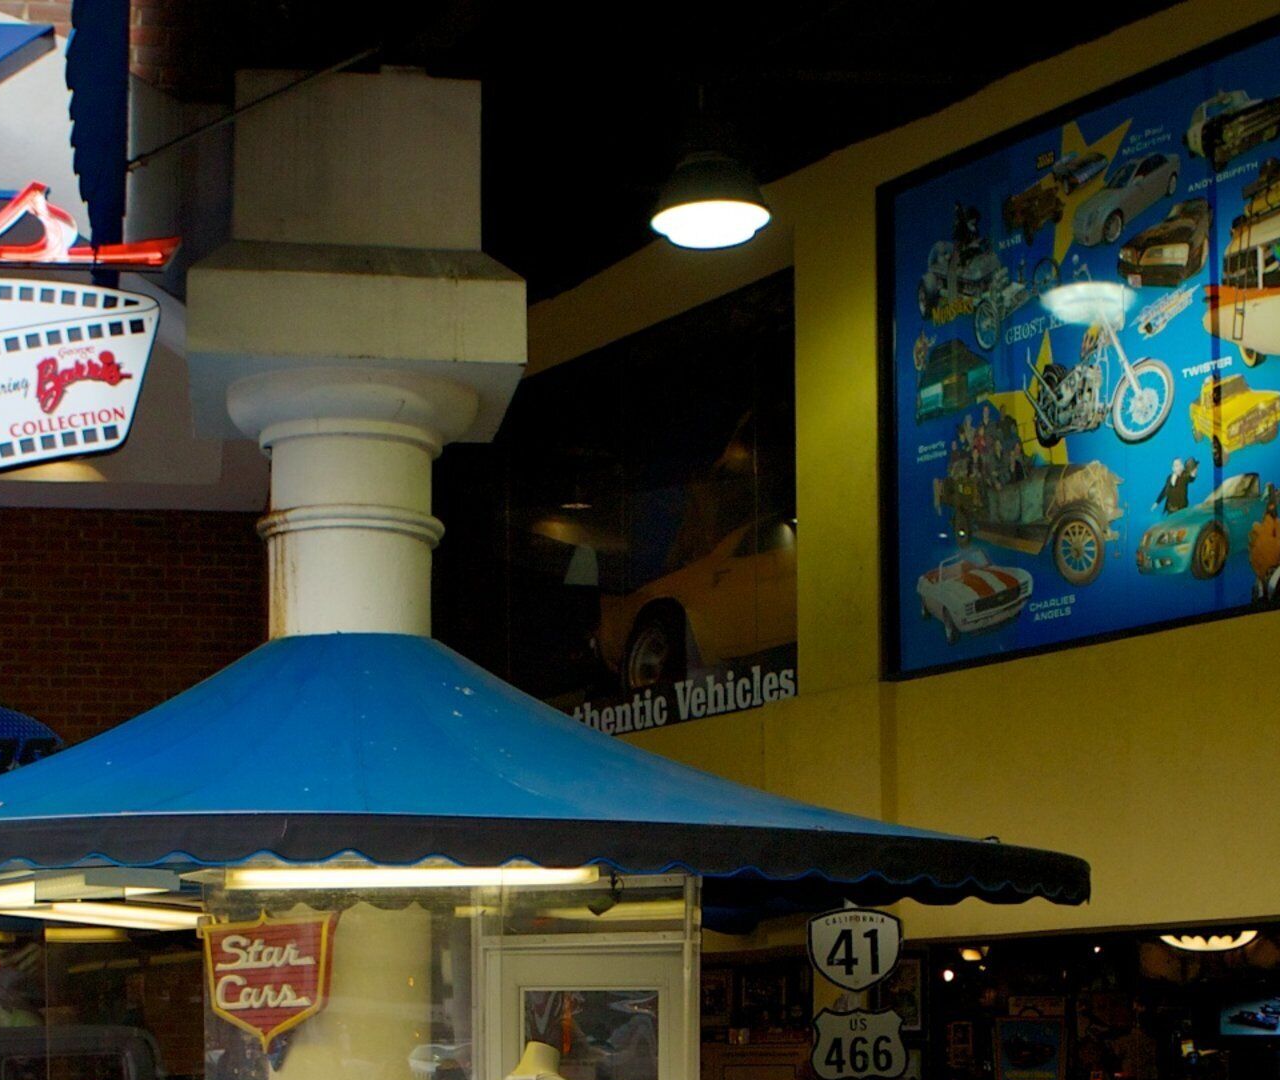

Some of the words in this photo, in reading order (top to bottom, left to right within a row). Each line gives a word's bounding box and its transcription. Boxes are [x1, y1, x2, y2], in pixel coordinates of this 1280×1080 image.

[1188, 177, 1213, 193] ANDY
[1215, 160, 1259, 184] GRIFFITH
[1004, 315, 1046, 345] GHOST
[1182, 356, 1233, 378] TWISTER
[9, 406, 126, 438] COLLECTION
[1028, 593, 1076, 612] CHARLIES
[1033, 606, 1072, 623] ANGELS
[674, 664, 796, 721] Vehicles
[825, 913, 886, 926] CALIFORNIA
[215, 935, 316, 972] Star
[826, 928, 880, 976] 41
[215, 974, 312, 1010] Cars
[849, 1018, 868, 1032] US
[824, 1035, 893, 1074] 466
